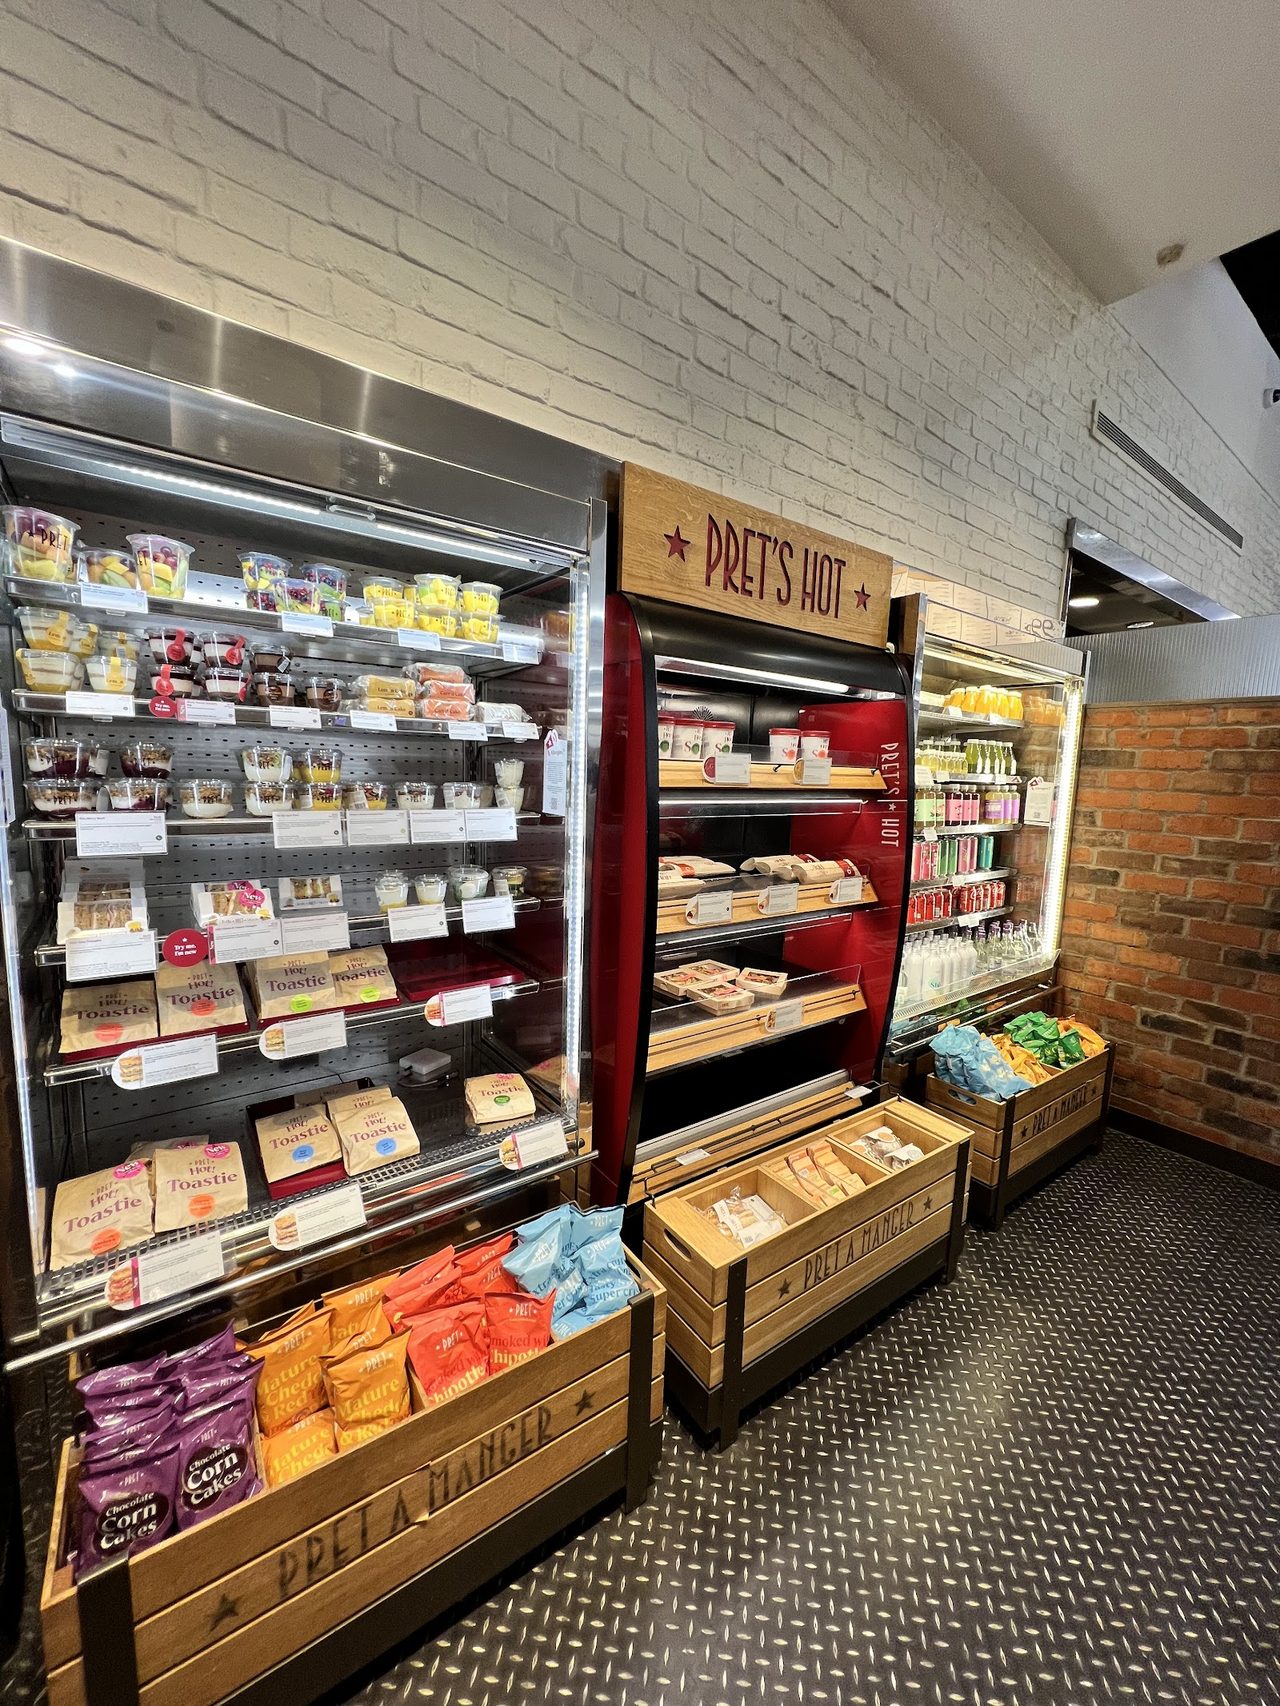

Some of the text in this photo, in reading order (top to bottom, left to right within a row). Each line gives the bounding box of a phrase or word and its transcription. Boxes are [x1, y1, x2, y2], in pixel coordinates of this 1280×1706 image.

[41, 528, 68, 551] PRET
[704, 512, 794, 606] PRET'S
[800, 547, 847, 619] HOT
[880, 742, 900, 848] PRET'S HOT
[243, 892, 262, 901] New
[174, 944, 184, 952] Try
[287, 959, 302, 968] PRET
[265, 974, 327, 993] Toastie
[334, 967, 387, 983] Toastie
[166, 986, 236, 1006] Toastie
[73, 1004, 150, 1020] Toastie
[368, 1111, 381, 1120] PRET
[268, 1123, 329, 1150] Toastie
[350, 1121, 407, 1144] Toastie
[206, 1143, 228, 1154] New
[114, 1159, 140, 1174] New
[194, 1158, 210, 1166] PRET
[166, 1171, 238, 1193] Toastie
[64, 1196, 143, 1234] Toastie
[803, 1200, 914, 1290] PRET A MANGER
[354, 1287, 374, 1307] PRET
[515, 1303, 533, 1317] PRET
[284, 1329, 306, 1353] PRET
[441, 1330, 459, 1352] PRET
[488, 1335, 532, 1348] moked
[366, 1351, 387, 1373] PRET
[340, 1378, 400, 1418] Mature
[200, 1428, 215, 1443] PRET
[189, 1443, 232, 1473] Chocolate
[123, 1473, 140, 1487] PRET
[186, 1451, 239, 1491] Corn
[190, 1467, 243, 1505] Cakes
[105, 1491, 155, 1517] Chocolate
[276, 1405, 552, 1601] PRET A MANGER
[101, 1502, 158, 1533] Corn
[99, 1519, 158, 1550] Cakes
